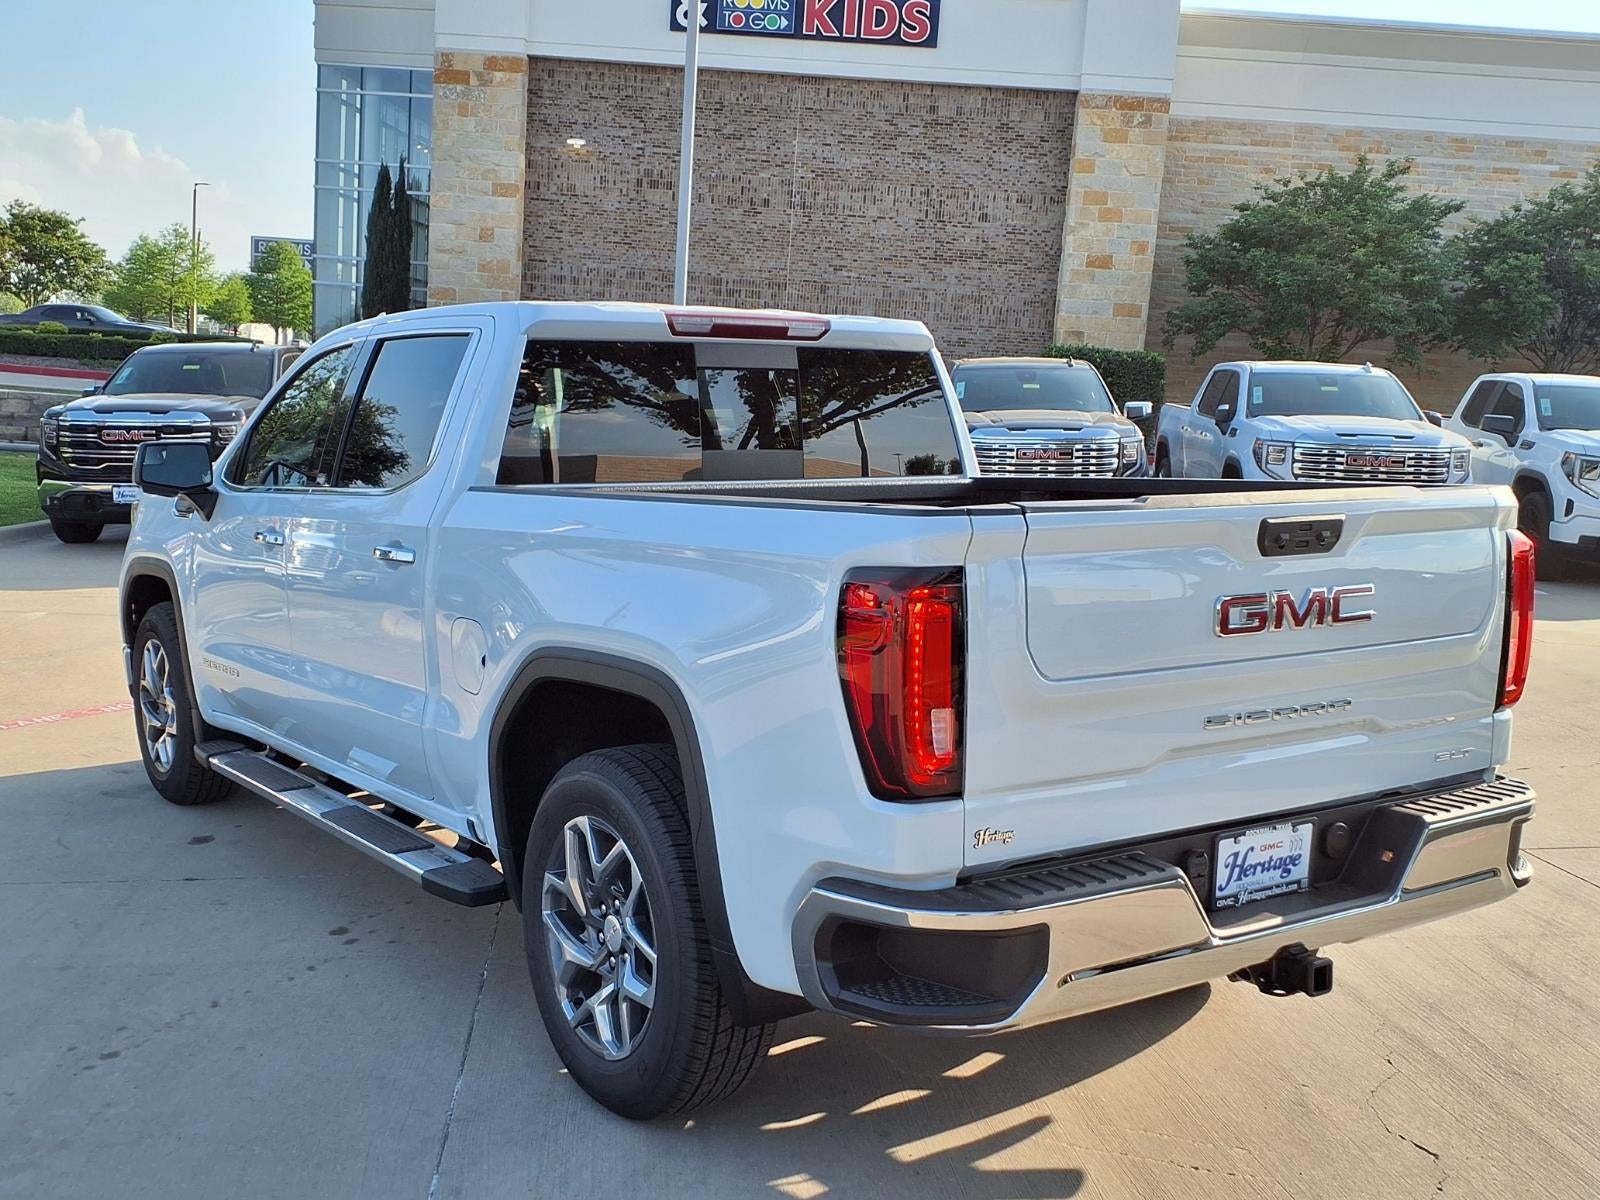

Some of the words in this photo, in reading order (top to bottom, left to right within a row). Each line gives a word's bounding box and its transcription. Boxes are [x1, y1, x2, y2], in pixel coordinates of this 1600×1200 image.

[723, 11, 746, 28] TO
[749, 12, 781, 28] GO
[803, 0, 931, 43] KIDS
[258, 240, 311, 256] RMS
[101, 429, 156, 441] GMC
[1017, 448, 1073, 460] GMC
[1347, 455, 1406, 468] GMC
[1213, 583, 1376, 637] GMC
[1203, 698, 1352, 730] SIERRA
[1434, 747, 1476, 762] SLT
[972, 827, 1016, 849] Heritage
[1260, 841, 1284, 852] GMC
[1217, 846, 1302, 891] Heritage
[1216, 897, 1236, 907] GMC
